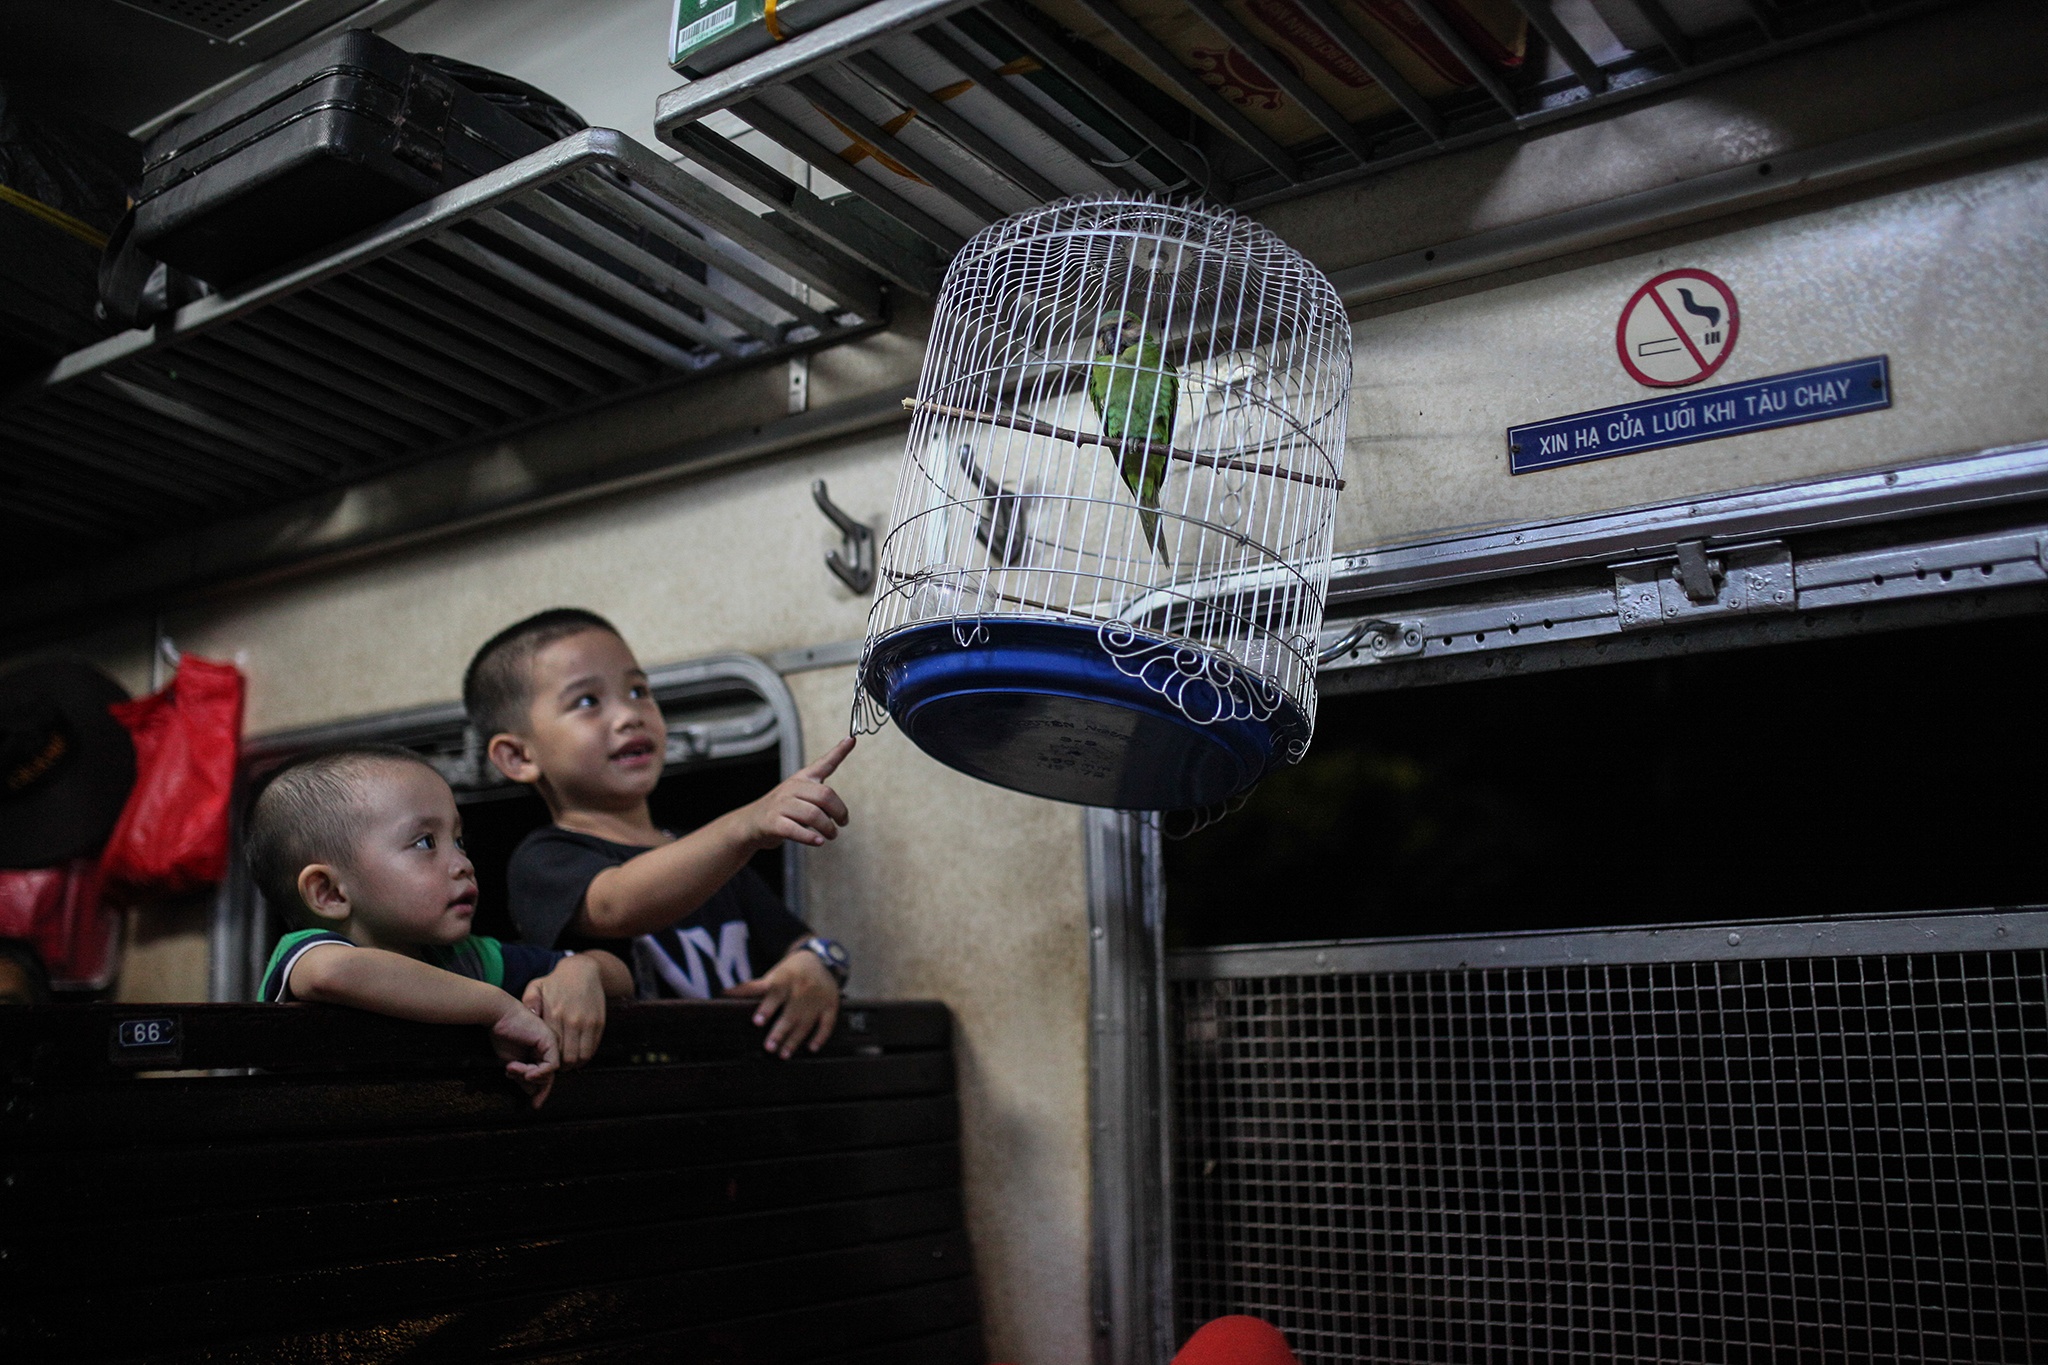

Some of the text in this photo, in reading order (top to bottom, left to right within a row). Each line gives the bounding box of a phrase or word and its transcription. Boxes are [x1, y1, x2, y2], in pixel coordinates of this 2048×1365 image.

[1540, 379, 1850, 455] XIN HẠ CỬA LƯỚI KHI TÀU CHẠY
[134, 1022, 160, 1042] 66
